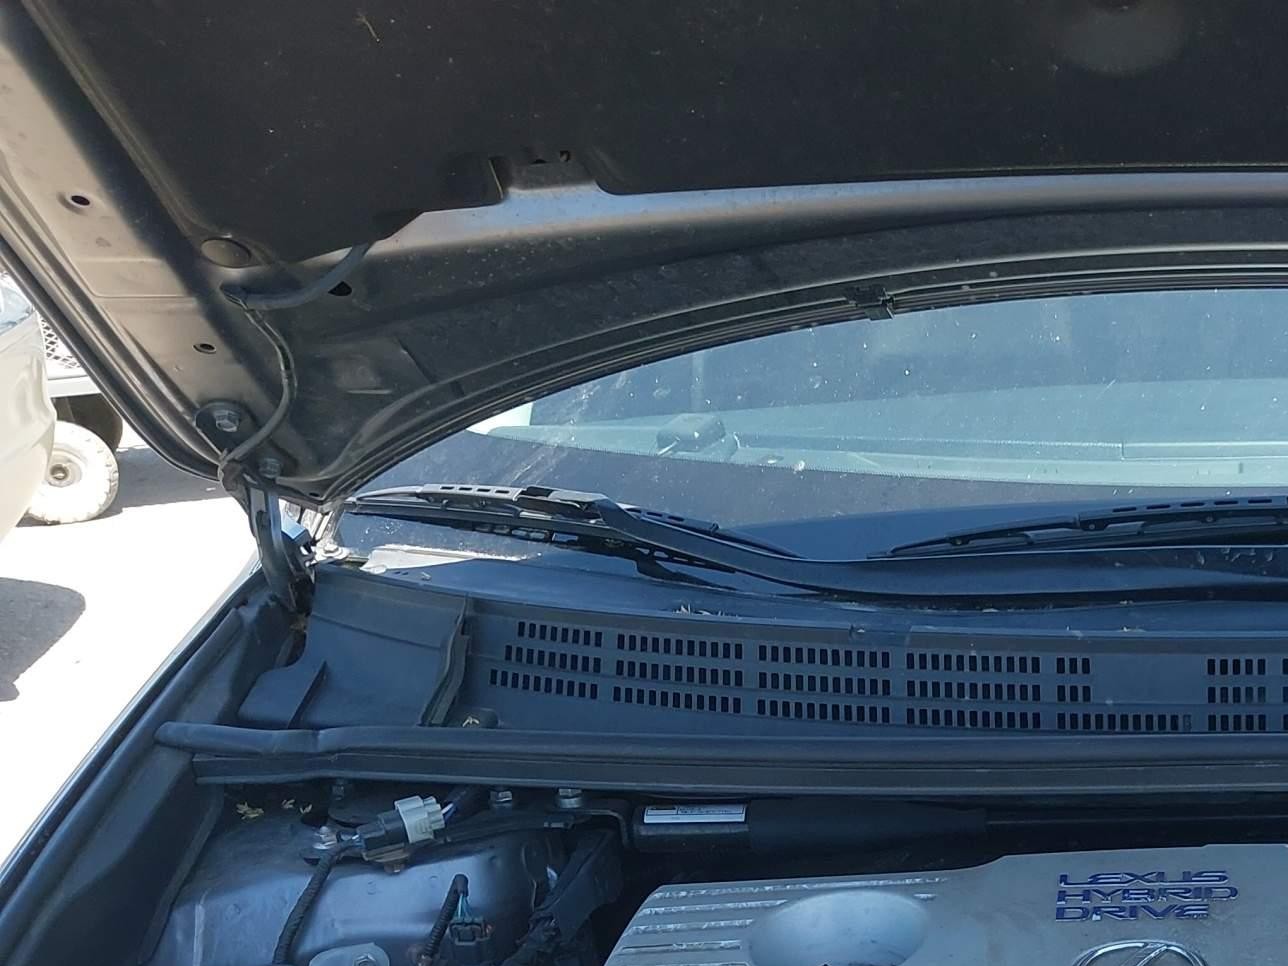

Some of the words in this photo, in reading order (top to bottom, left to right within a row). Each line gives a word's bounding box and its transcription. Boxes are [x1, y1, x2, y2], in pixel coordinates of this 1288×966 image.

[1058, 870, 1230, 887] LEXUS
[1056, 886, 1239, 905] HYBRID
[1055, 903, 1210, 922] DRIVE
